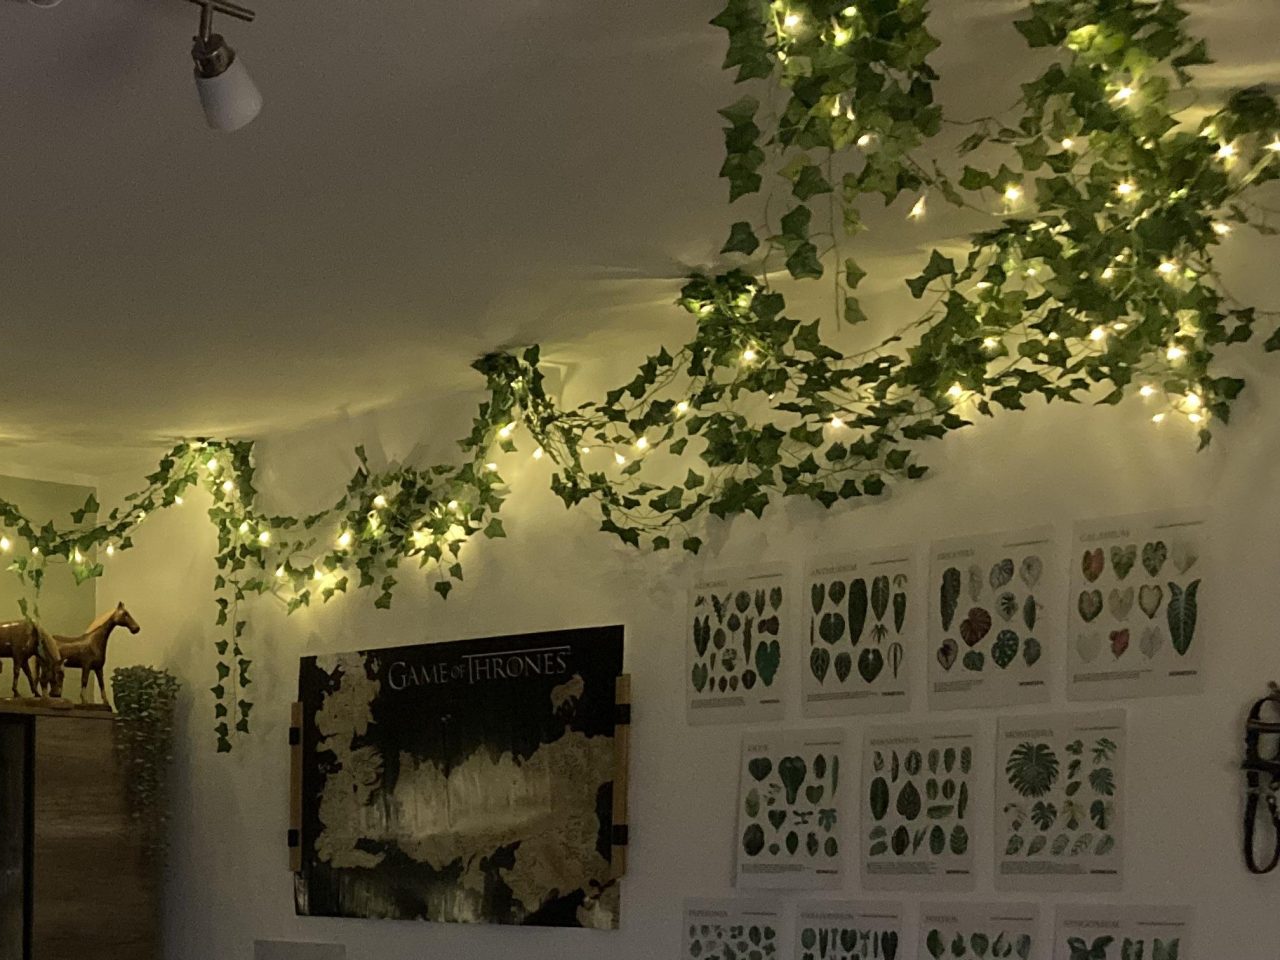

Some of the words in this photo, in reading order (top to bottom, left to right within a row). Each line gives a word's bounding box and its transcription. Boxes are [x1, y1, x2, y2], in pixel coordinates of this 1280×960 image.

[388, 660, 447, 690] GAME
[451, 663, 466, 679] OF
[463, 646, 570, 685] THRONES
